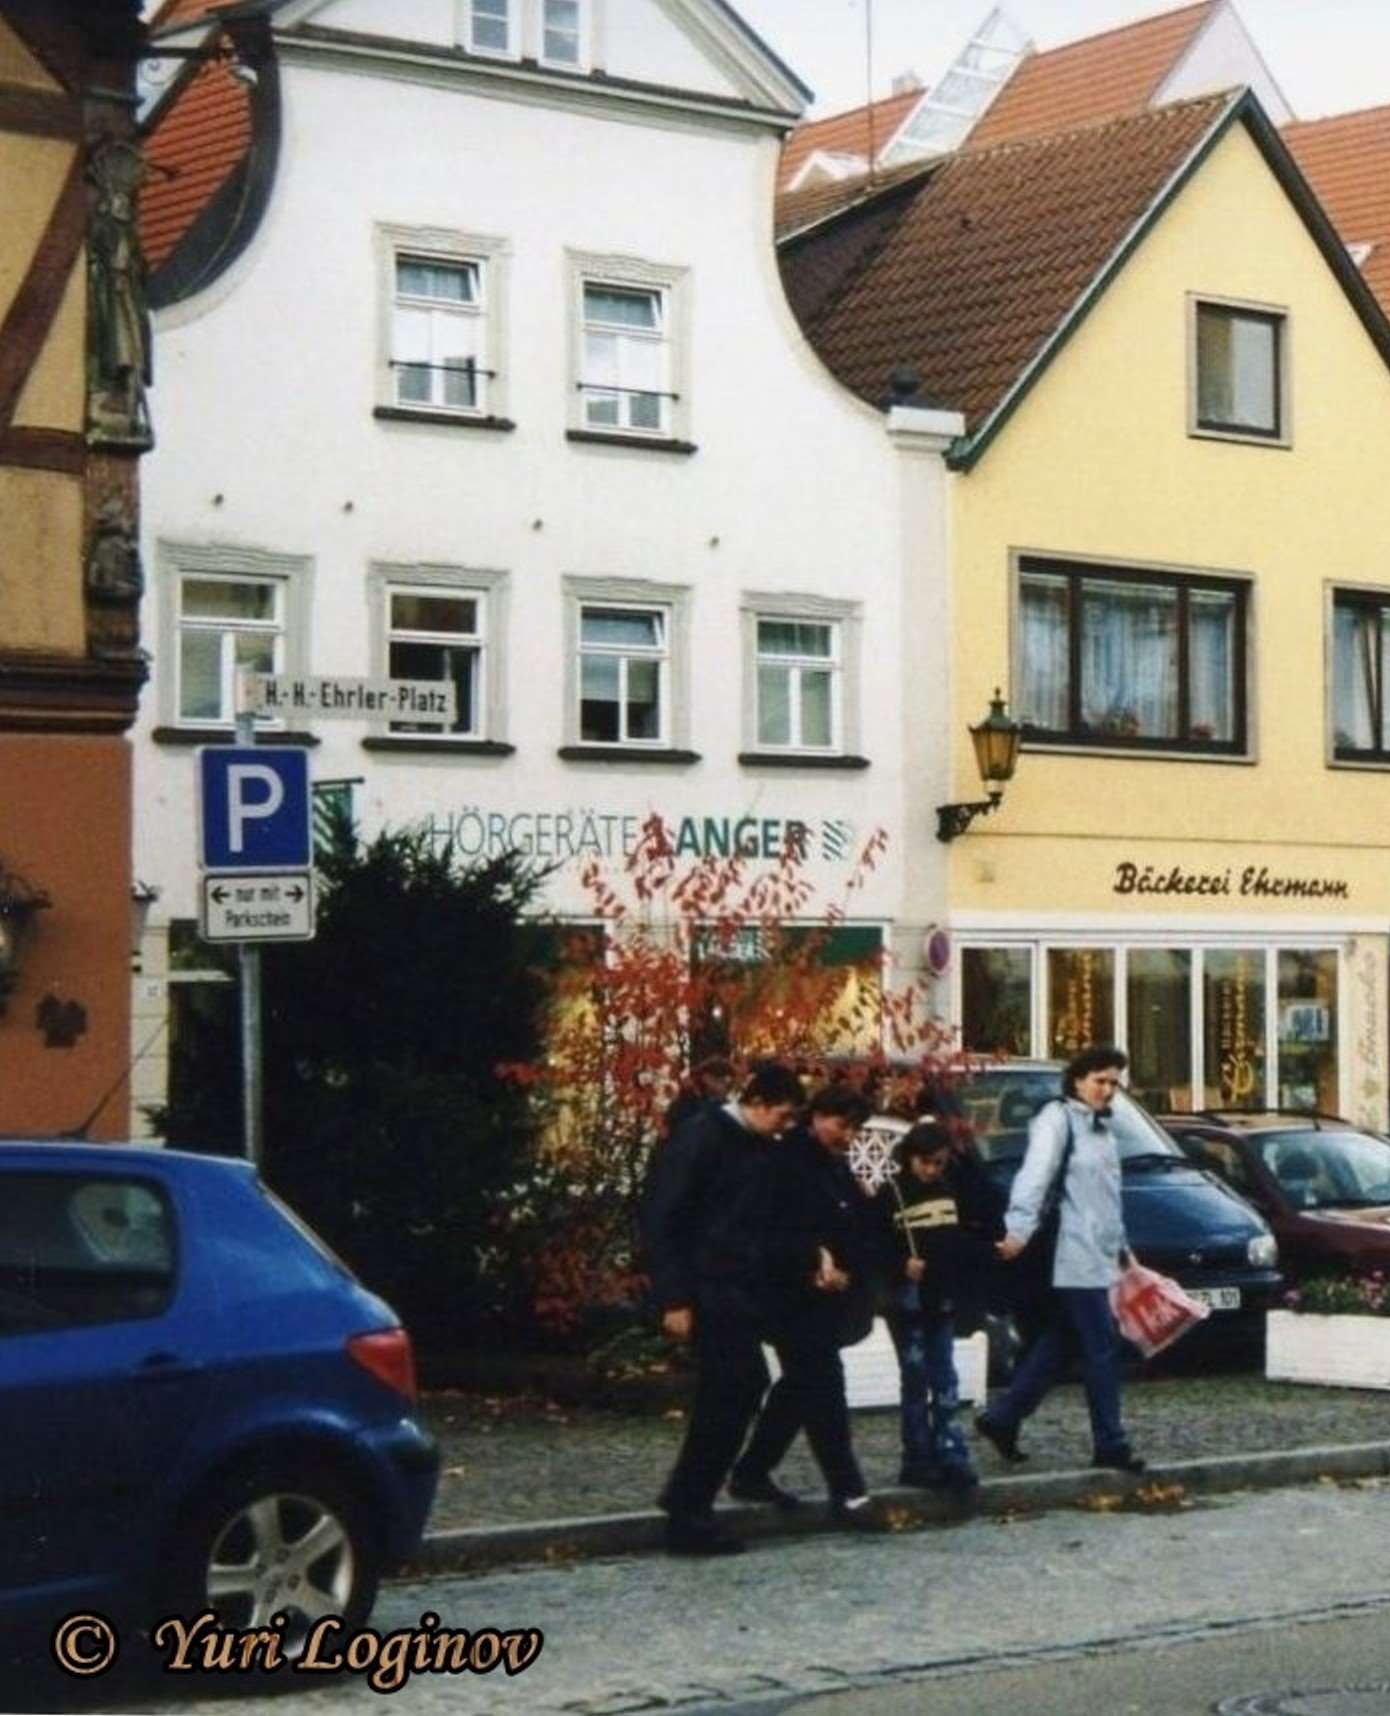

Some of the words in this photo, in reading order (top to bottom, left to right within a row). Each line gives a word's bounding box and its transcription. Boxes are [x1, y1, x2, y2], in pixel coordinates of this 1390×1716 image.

[226, 763, 285, 853] P
[430, 806, 638, 858] HÖRGERÄTE
[650, 814, 807, 860] ANGER
[1113, 861, 1230, 896] Bäckerei
[1239, 866, 1349, 899] Ehrmann
[225, 908, 291, 928] Parkschein
